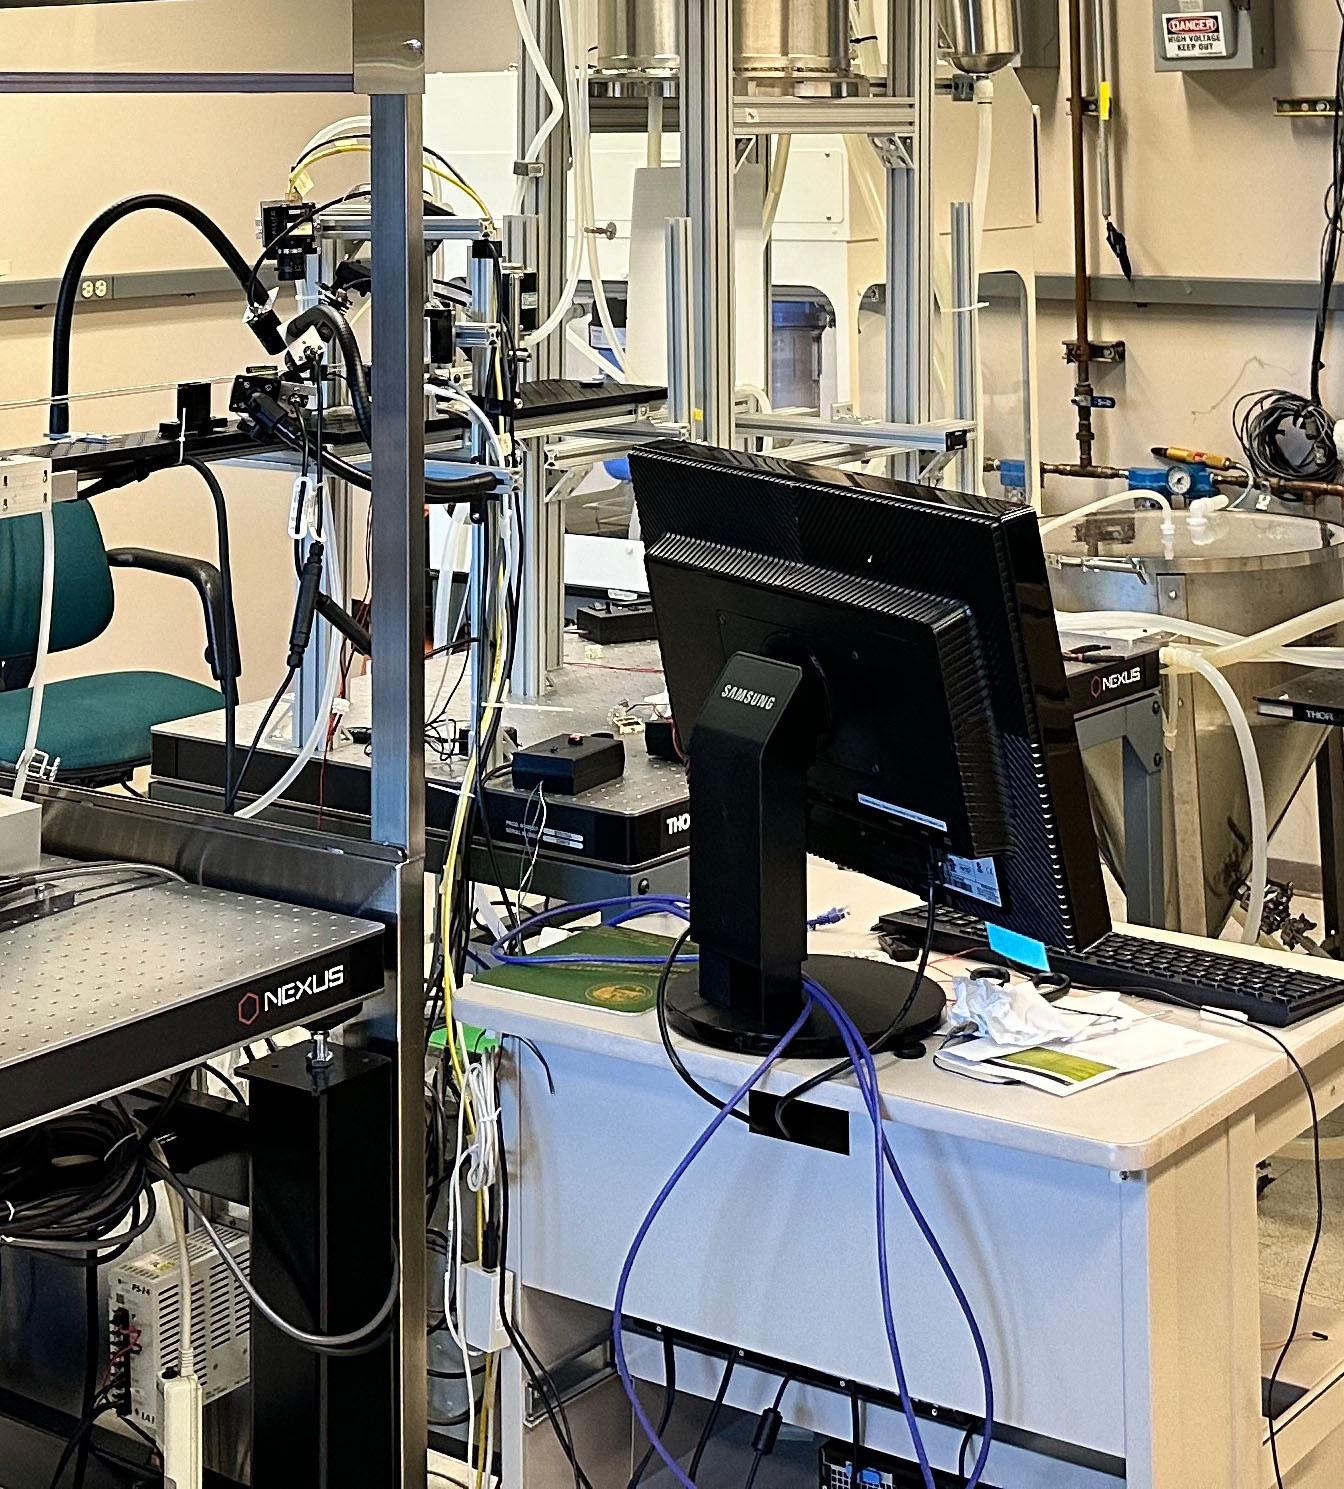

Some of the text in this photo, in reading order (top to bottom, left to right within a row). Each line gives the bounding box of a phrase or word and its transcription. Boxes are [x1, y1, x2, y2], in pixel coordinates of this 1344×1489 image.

[1171, 19, 1215, 31] DANGER
[1168, 34, 1221, 43] HIGH VOLTAGE
[1102, 667, 1141, 691] NEXUS
[721, 684, 776, 710] SAMSUNG
[264, 964, 344, 1012] NEXUS
